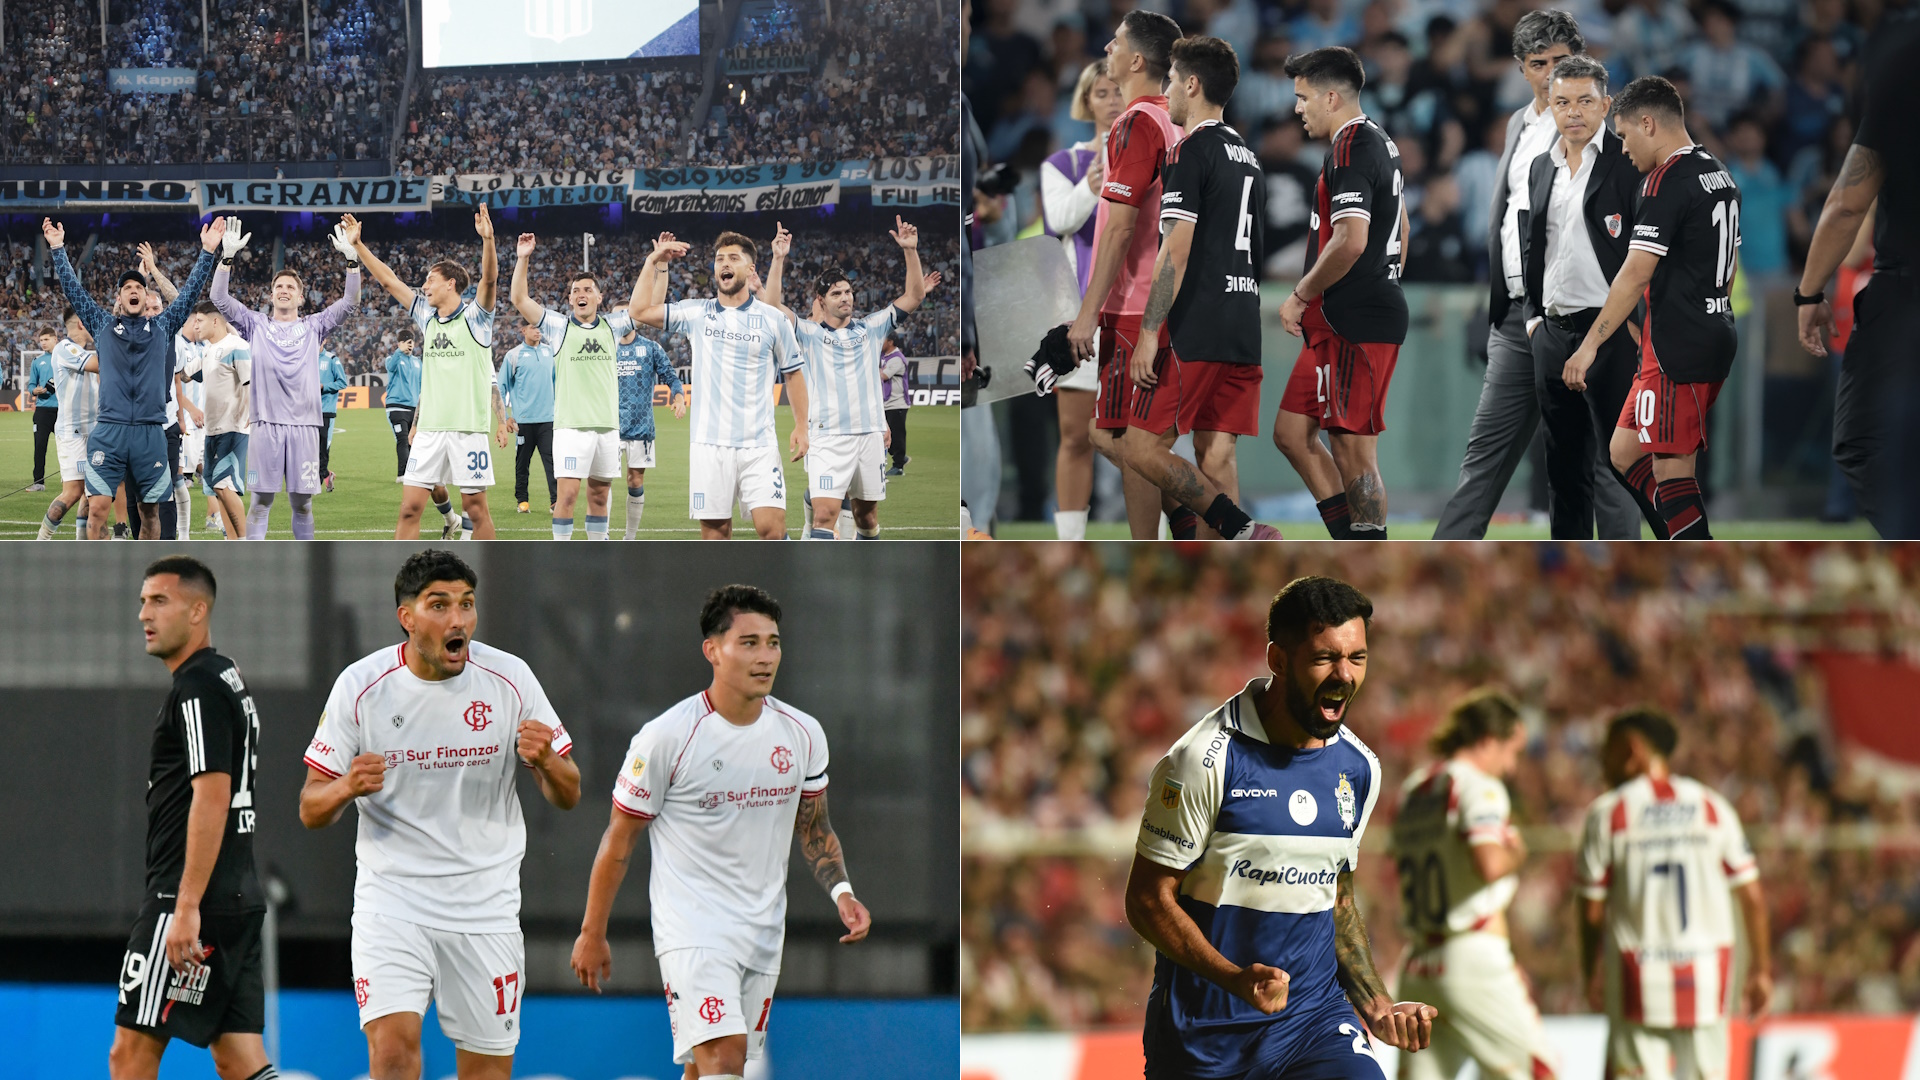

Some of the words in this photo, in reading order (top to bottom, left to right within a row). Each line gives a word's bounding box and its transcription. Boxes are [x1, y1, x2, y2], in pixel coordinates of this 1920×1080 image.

[136, 74, 196, 88] Kappa
[873, 157, 921, 181] LOS
[512, 169, 624, 189] RACING
[206, 178, 424, 207] M.GRANDE
[468, 189, 532, 210] VIVE
[538, 185, 625, 206] MEJOR
[881, 188, 918, 204] FUI
[1109, 187, 1132, 198] CARD
[1235, 175, 1254, 264] 4
[1637, 230, 1659, 238] CARD
[1712, 199, 1739, 288] 10
[704, 325, 761, 343] betsson
[446, 350, 465, 358] CLUB
[1315, 363, 1330, 403] 21
[1635, 389, 1656, 427] 10
[467, 451, 489, 470] 30
[301, 461, 318, 480] 25
[772, 467, 783, 489] 3
[406, 749, 431, 761] Sur
[437, 744, 499, 759] Finanzas
[418, 762, 430, 770] Tu
[433, 760, 464, 769] futuro
[467, 758, 490, 767] cerca
[727, 790, 749, 802] Sur
[1231, 789, 1278, 798] GIVOVA
[746, 800, 774, 808] futuro
[1142, 818, 1195, 850] Casablanca
[1229, 859, 1336, 886] RapiCuota
[1652, 861, 1688, 933] 7
[493, 970, 518, 1015] 17
